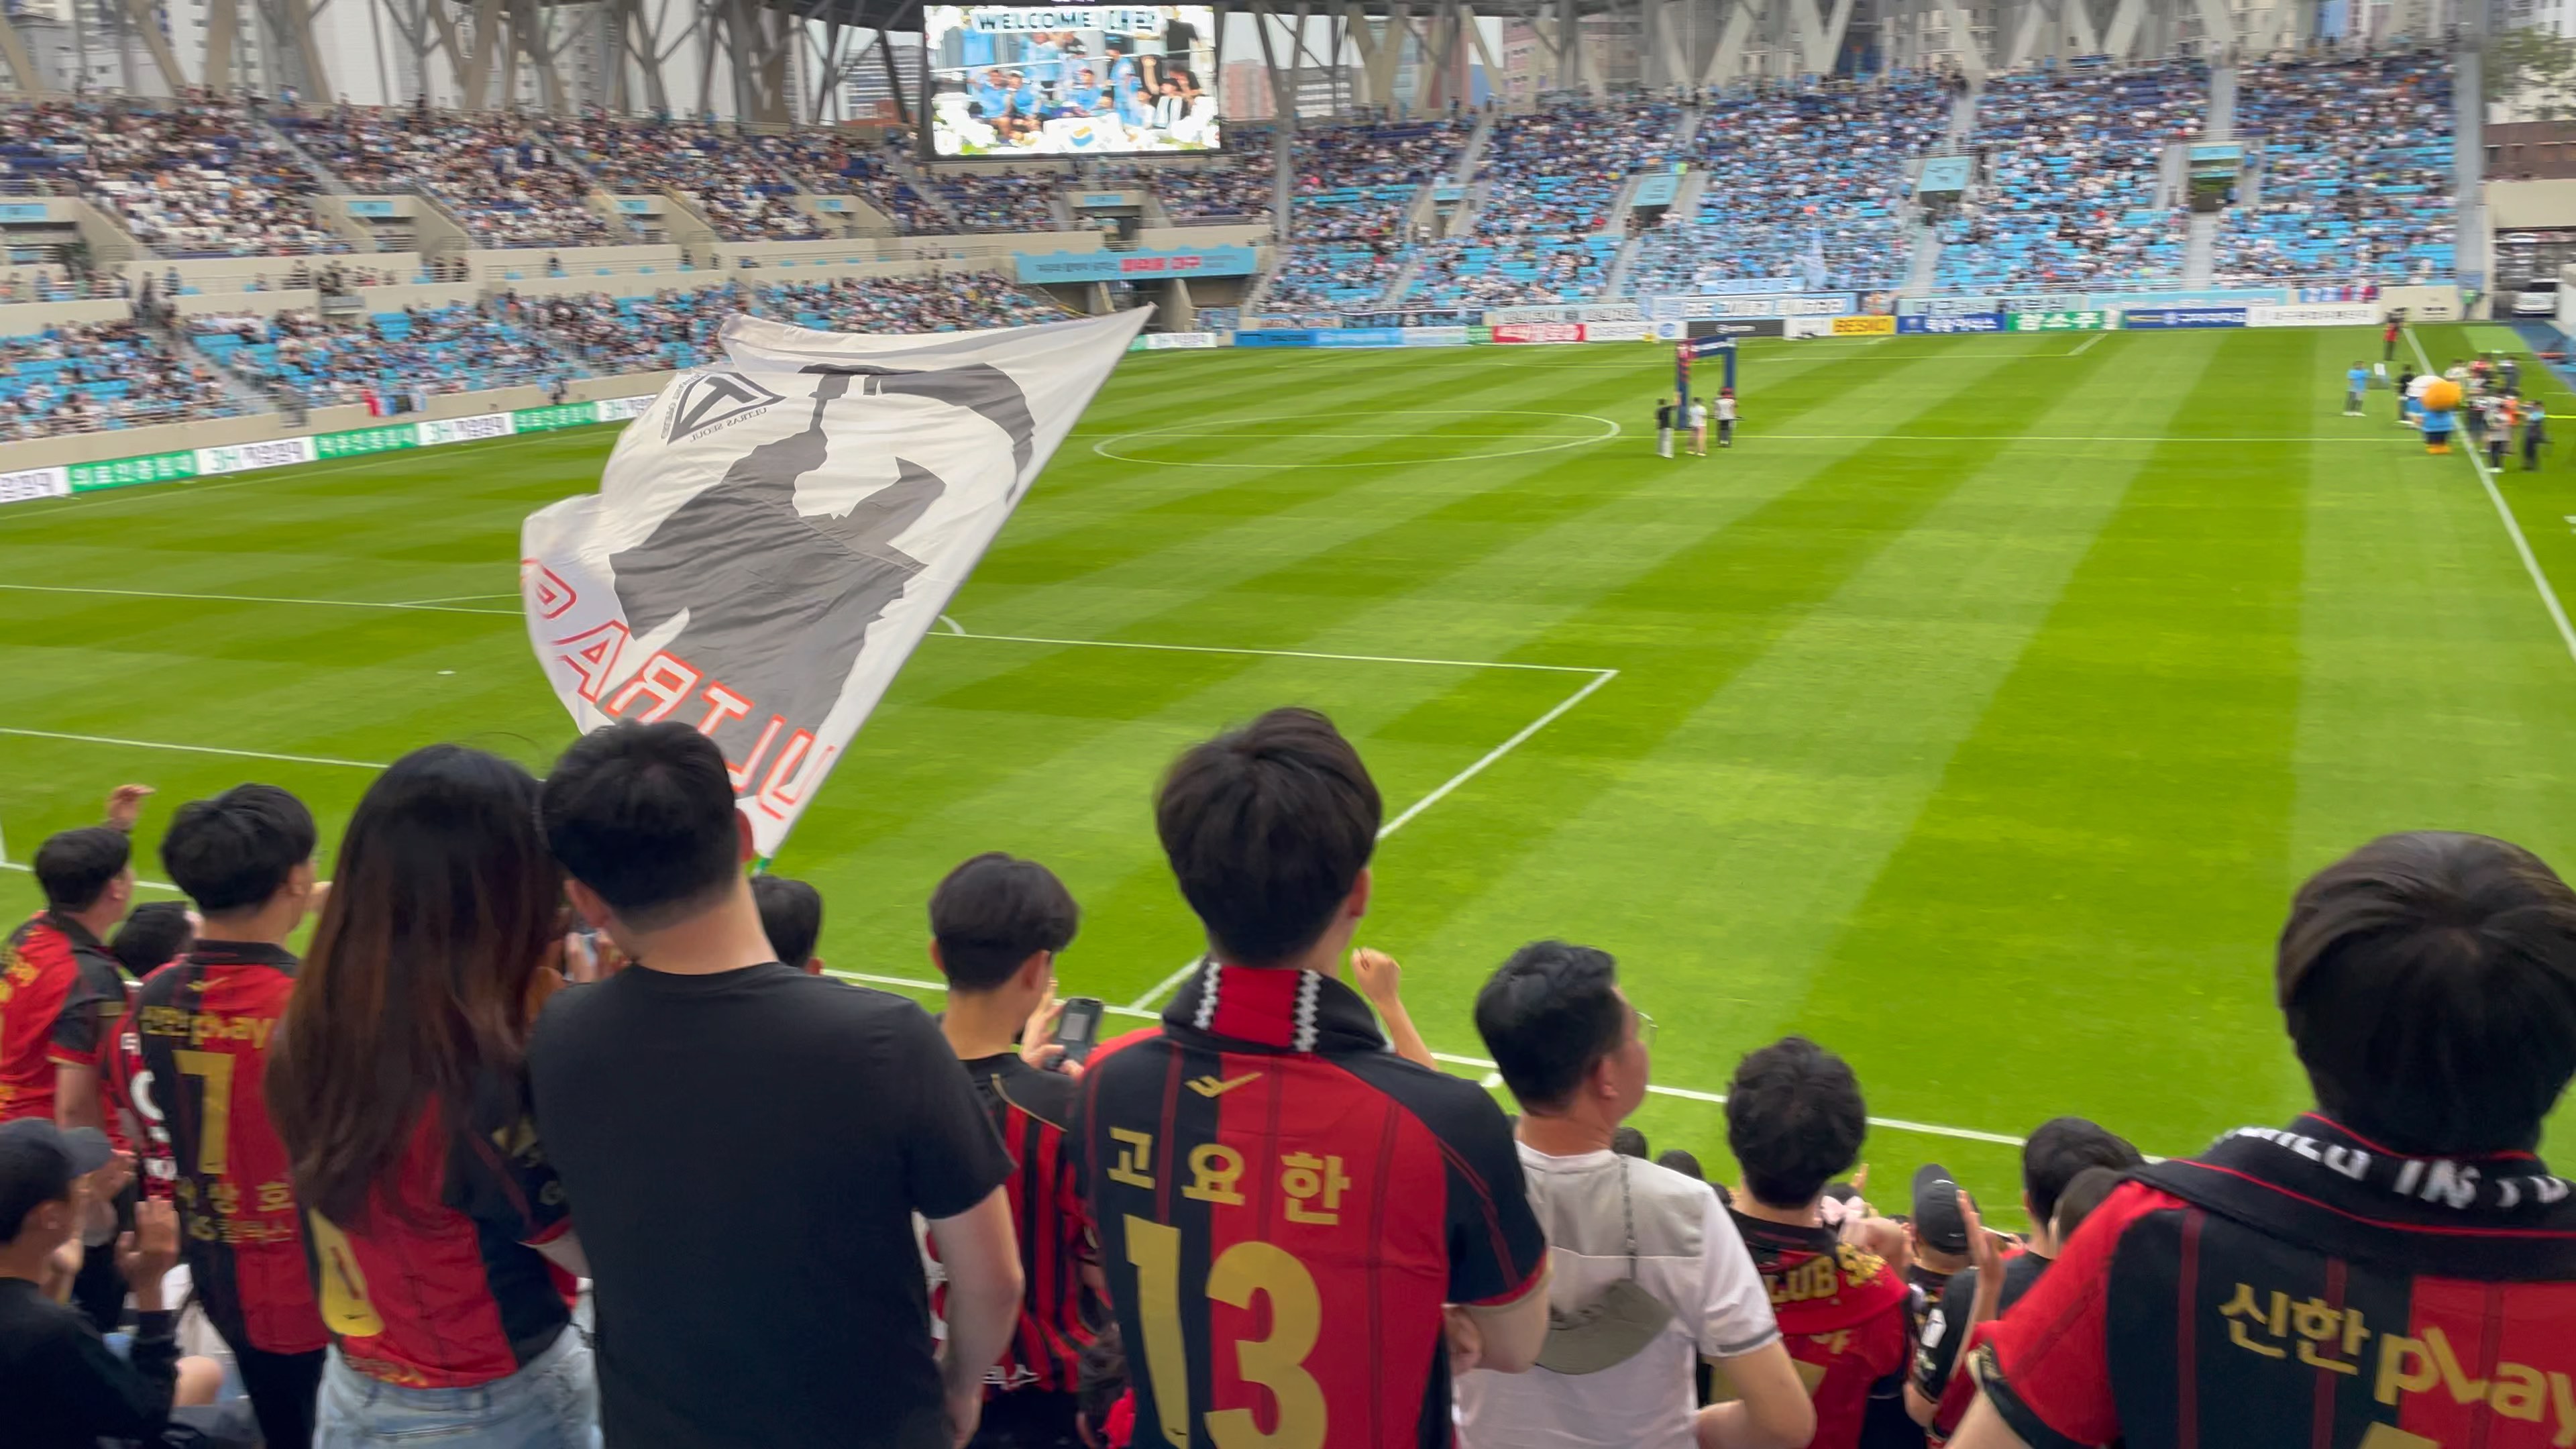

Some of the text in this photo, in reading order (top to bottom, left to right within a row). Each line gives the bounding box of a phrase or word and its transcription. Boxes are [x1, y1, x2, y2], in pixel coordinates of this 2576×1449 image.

[979, 10, 1092, 30] WELCOME
[172, 1049, 235, 1175] 7
[1107, 1126, 1350, 1226] 고요한
[1124, 1214, 1329, 1449] 13
[2218, 1282, 2371, 1375] 신한
